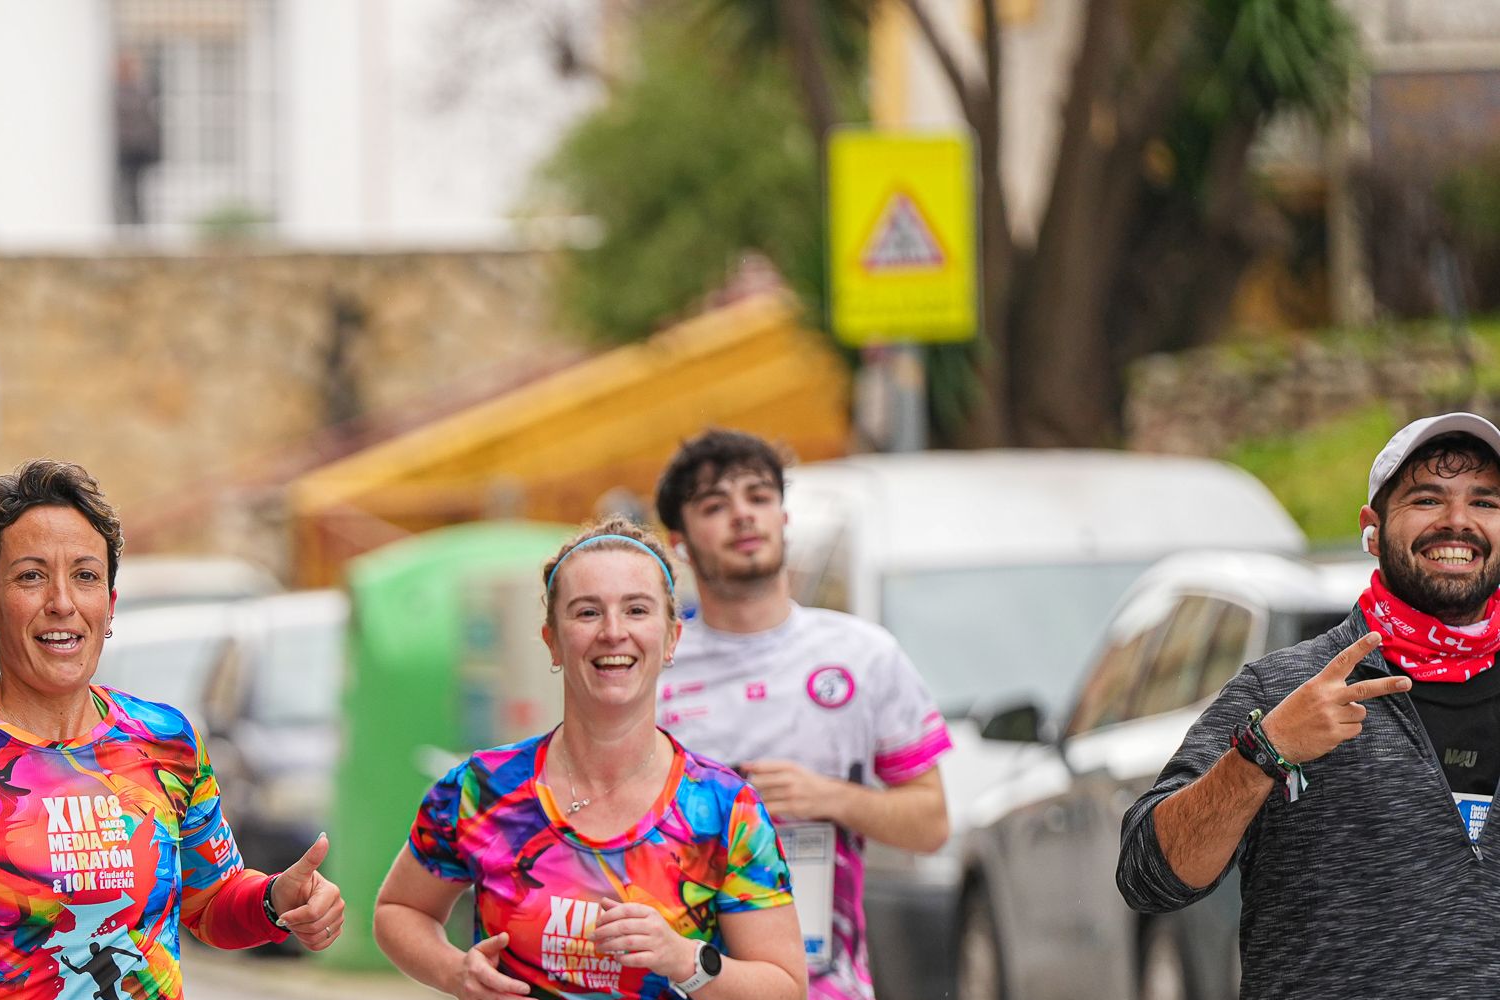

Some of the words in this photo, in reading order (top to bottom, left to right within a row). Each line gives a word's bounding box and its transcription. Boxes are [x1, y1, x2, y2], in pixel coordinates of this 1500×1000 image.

[42, 795, 97, 833] XII
[94, 794, 123, 818] 08
[98, 819, 126, 829] MARZO
[47, 832, 103, 852] MEDIA
[101, 829, 129, 842] 2026
[50, 846, 134, 872] MARATÓN
[53, 880, 62, 893] &
[63, 871, 97, 892] 10K
[100, 871, 123, 879] Ciudad
[126, 870, 134, 878] de
[100, 878, 134, 890] LUCENA
[542, 935, 596, 956] MEDIA
[542, 952, 622, 973] MARATÓN
